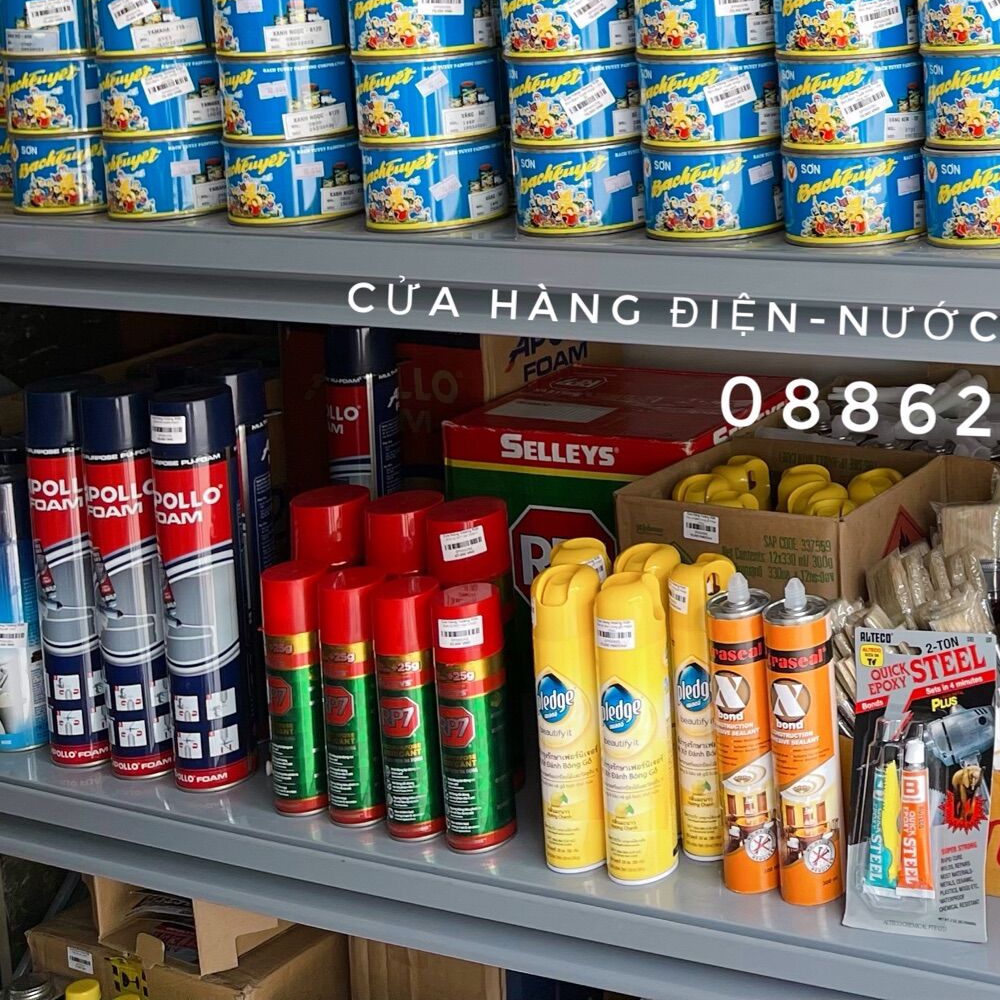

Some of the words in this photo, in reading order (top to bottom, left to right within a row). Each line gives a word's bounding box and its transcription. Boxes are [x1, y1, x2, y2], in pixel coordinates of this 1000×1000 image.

[800, 163, 821, 175] SƠN
[940, 162, 961, 175] SƠN
[763, 535, 777, 548] SAP
[860, 631, 891, 643] ALTECO
[926, 636, 959, 654] 2-TON
[909, 644, 987, 684] STEEL
[870, 662, 911, 681] QUICK
[868, 675, 907, 696] EPOXY
[925, 685, 942, 695] Sets
[943, 682, 949, 691] in
[955, 676, 983, 688] minutes
[861, 700, 884, 711] Bonds
[776, 721, 804, 729] bond
